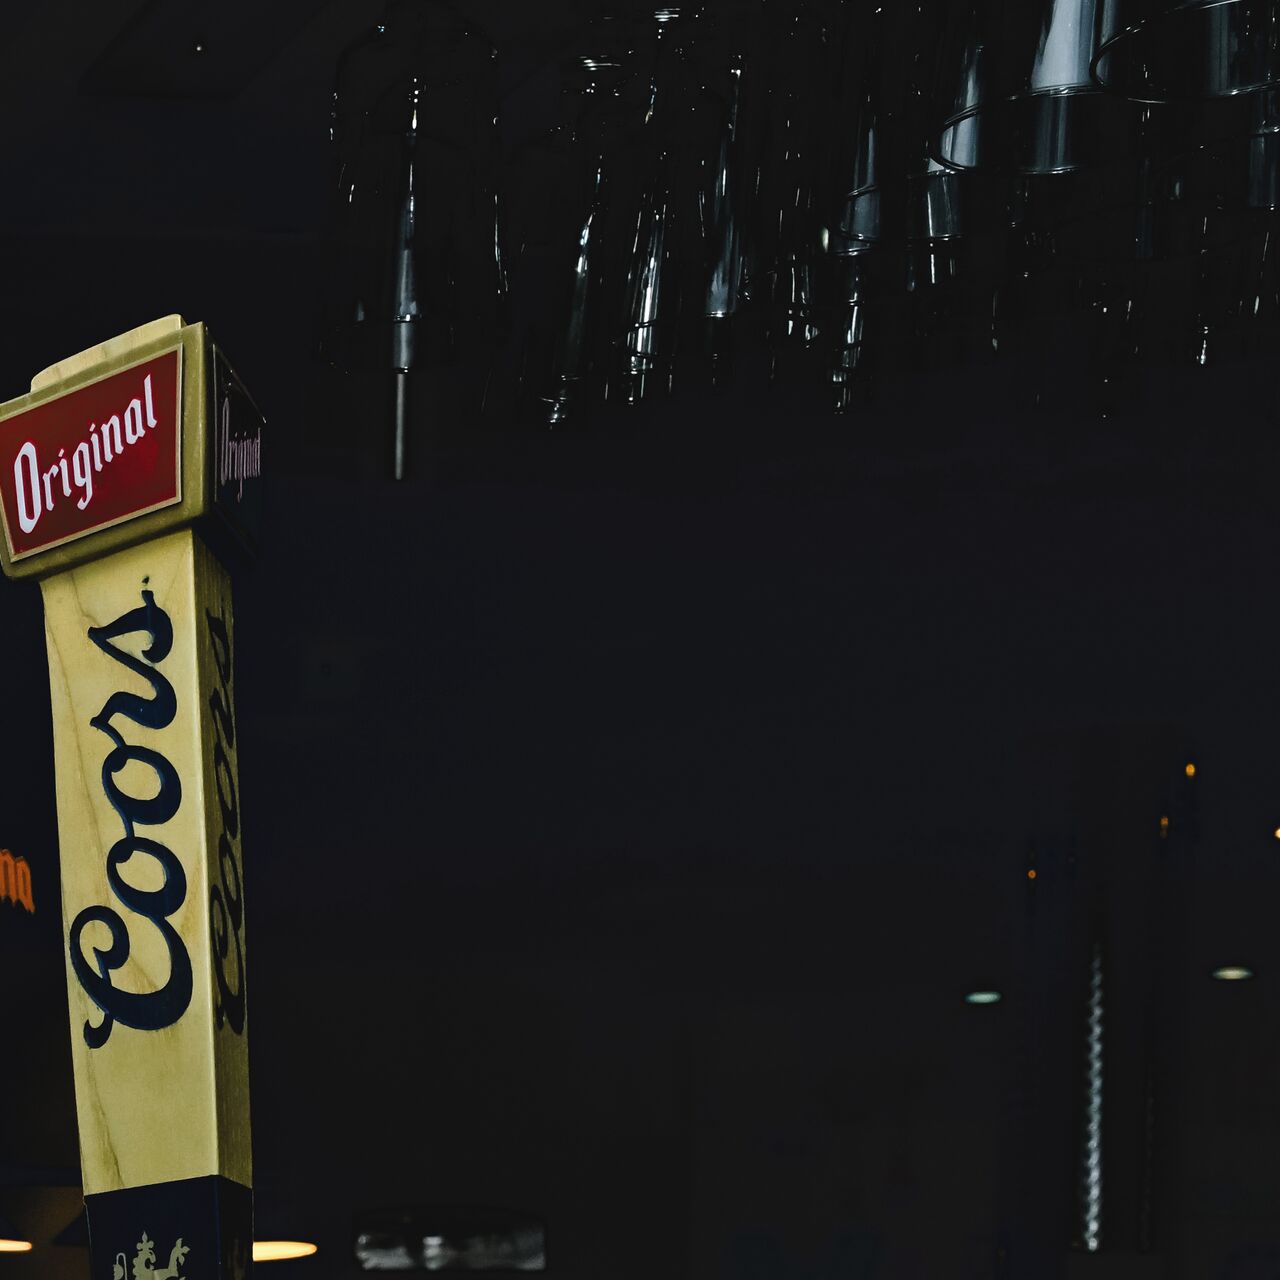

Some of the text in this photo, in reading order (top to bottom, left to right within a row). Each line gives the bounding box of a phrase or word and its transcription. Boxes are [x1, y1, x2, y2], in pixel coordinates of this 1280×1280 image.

[13, 373, 158, 534] Original
[221, 397, 261, 502] Original
[70, 588, 193, 1049] Coors
[206, 606, 245, 1036] Coors
